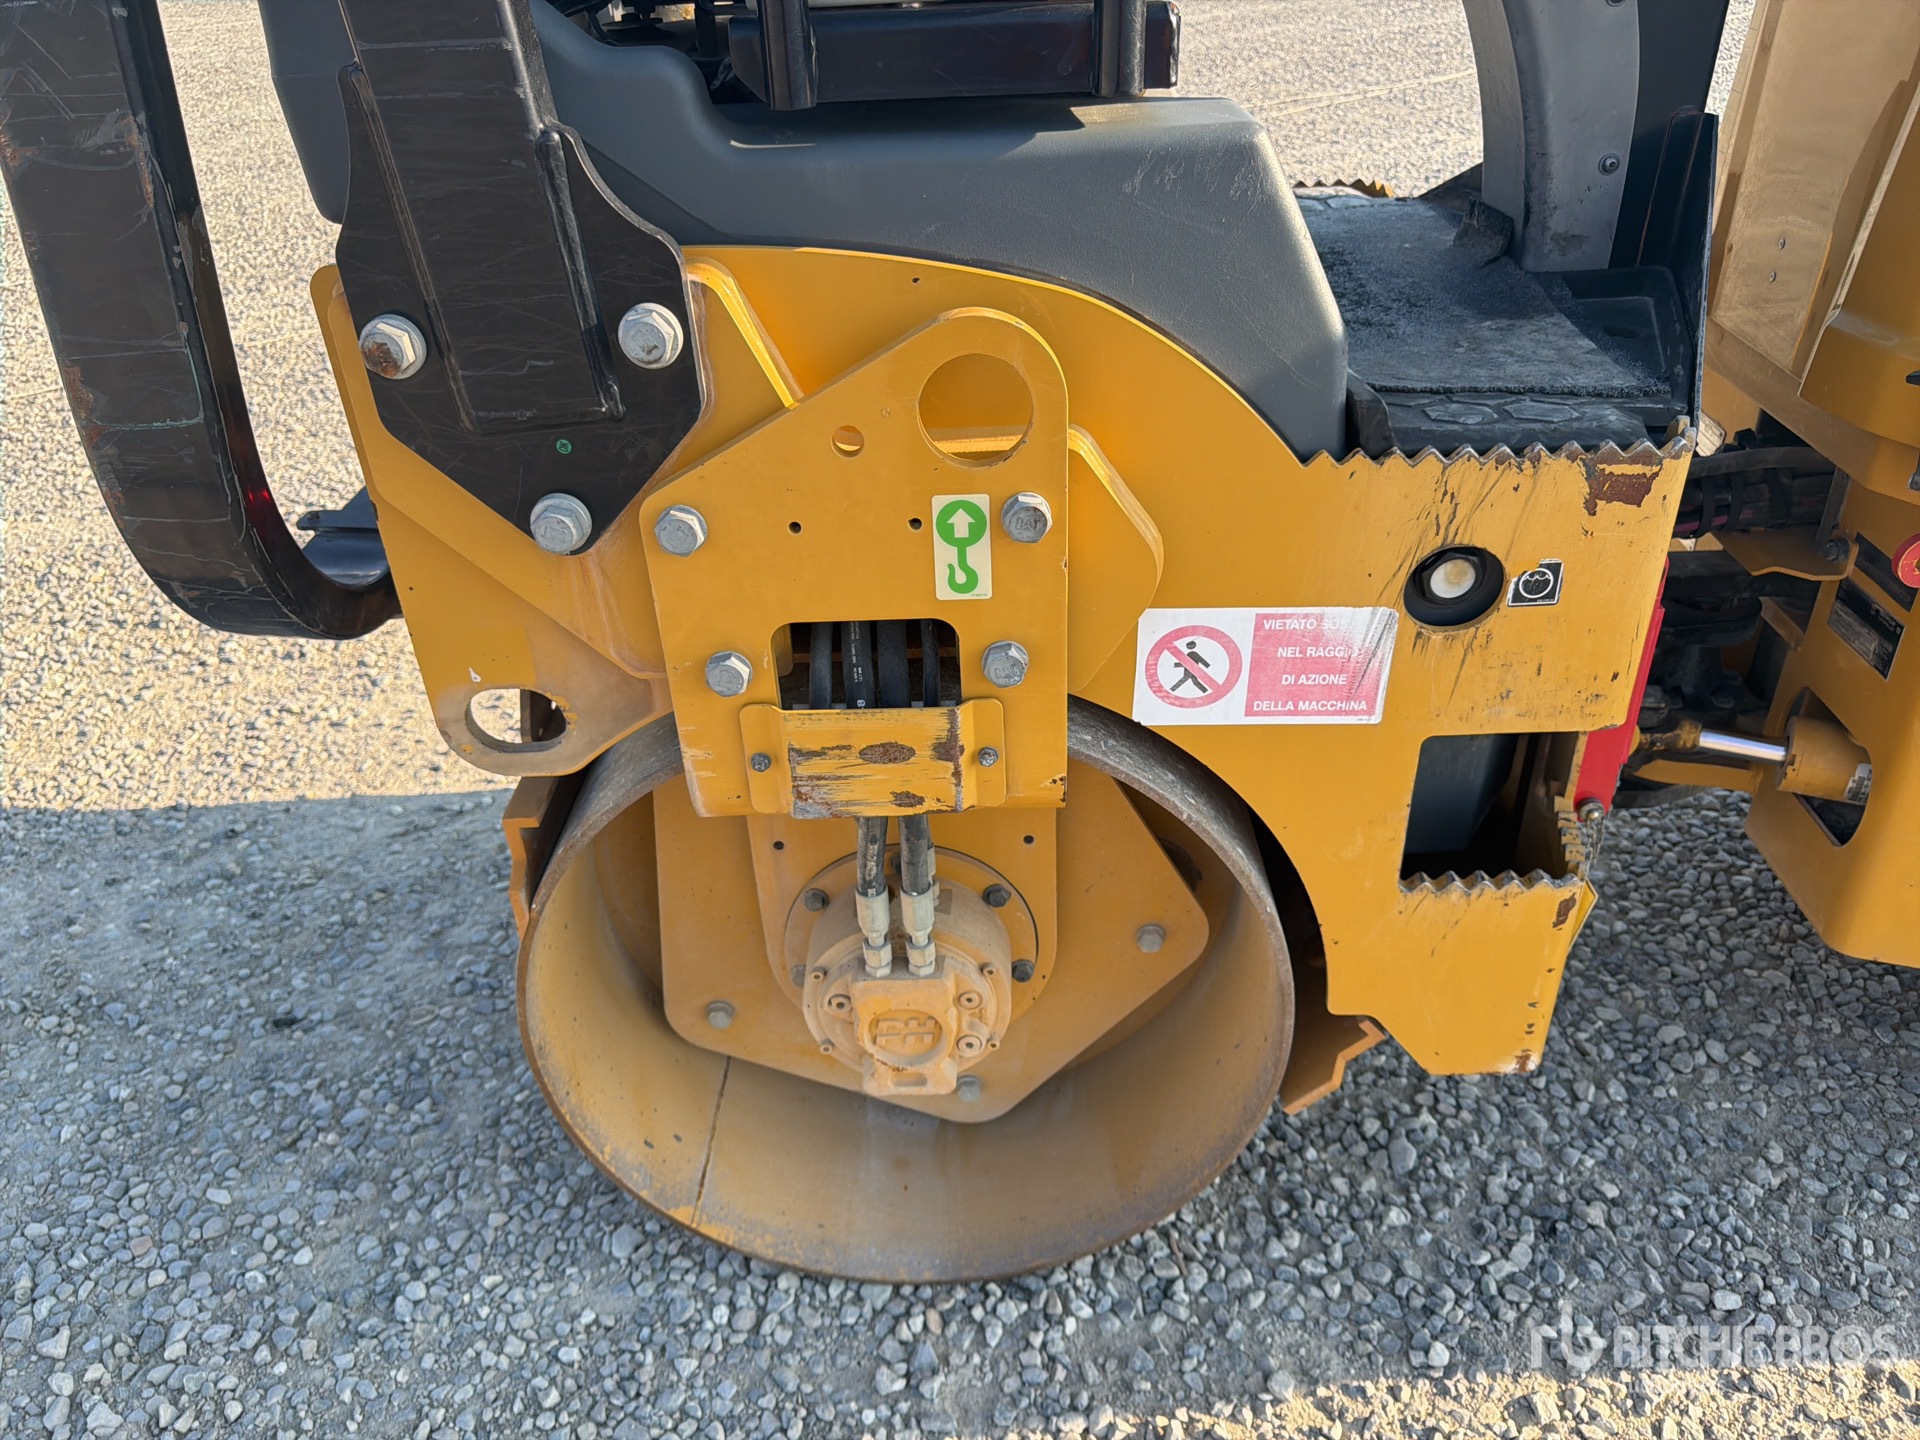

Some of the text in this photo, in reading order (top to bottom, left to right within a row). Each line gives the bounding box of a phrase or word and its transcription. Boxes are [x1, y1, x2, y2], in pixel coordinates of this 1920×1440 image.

[558, 440, 571, 454] OK
[1263, 619, 1317, 630] VIETATO
[1277, 646, 1360, 658] NEL RAGGIO
[1281, 673, 1348, 685] DI AZIONE
[1253, 700, 1367, 711] DELLA MACCHINA
